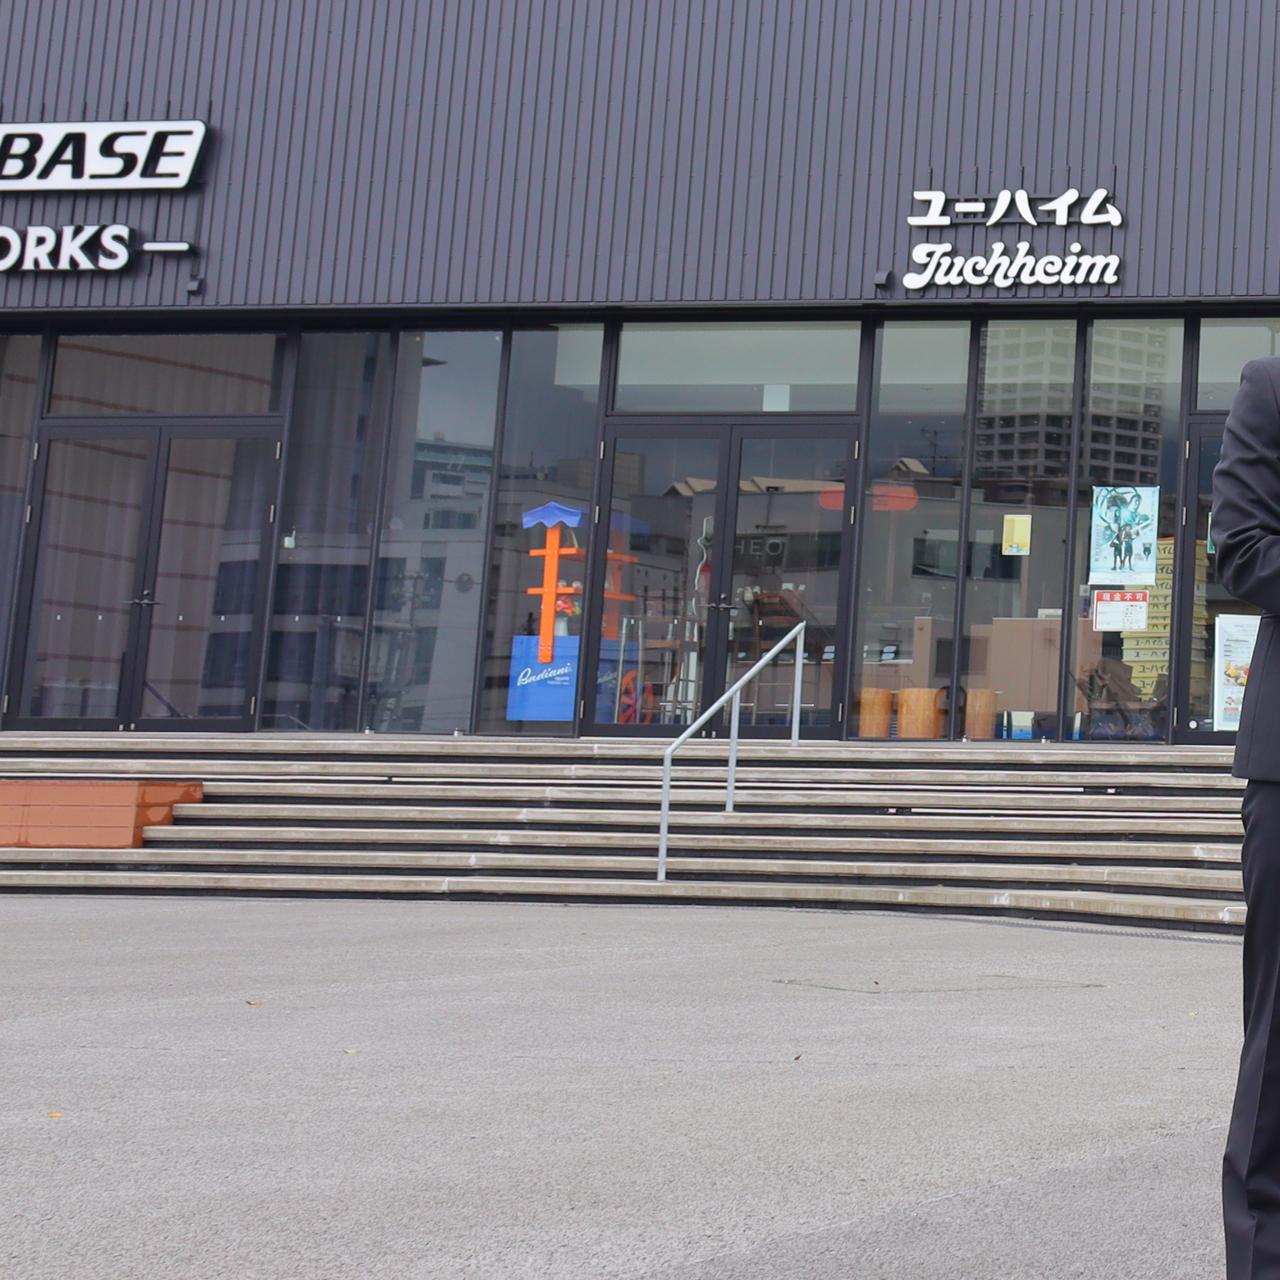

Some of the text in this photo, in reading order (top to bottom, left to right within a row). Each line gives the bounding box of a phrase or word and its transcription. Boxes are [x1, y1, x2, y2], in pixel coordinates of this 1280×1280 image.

[0, 131, 194, 180] BASE
[906, 187, 1122, 227] ユーハイム
[902, 240, 1121, 290] Juchheim
